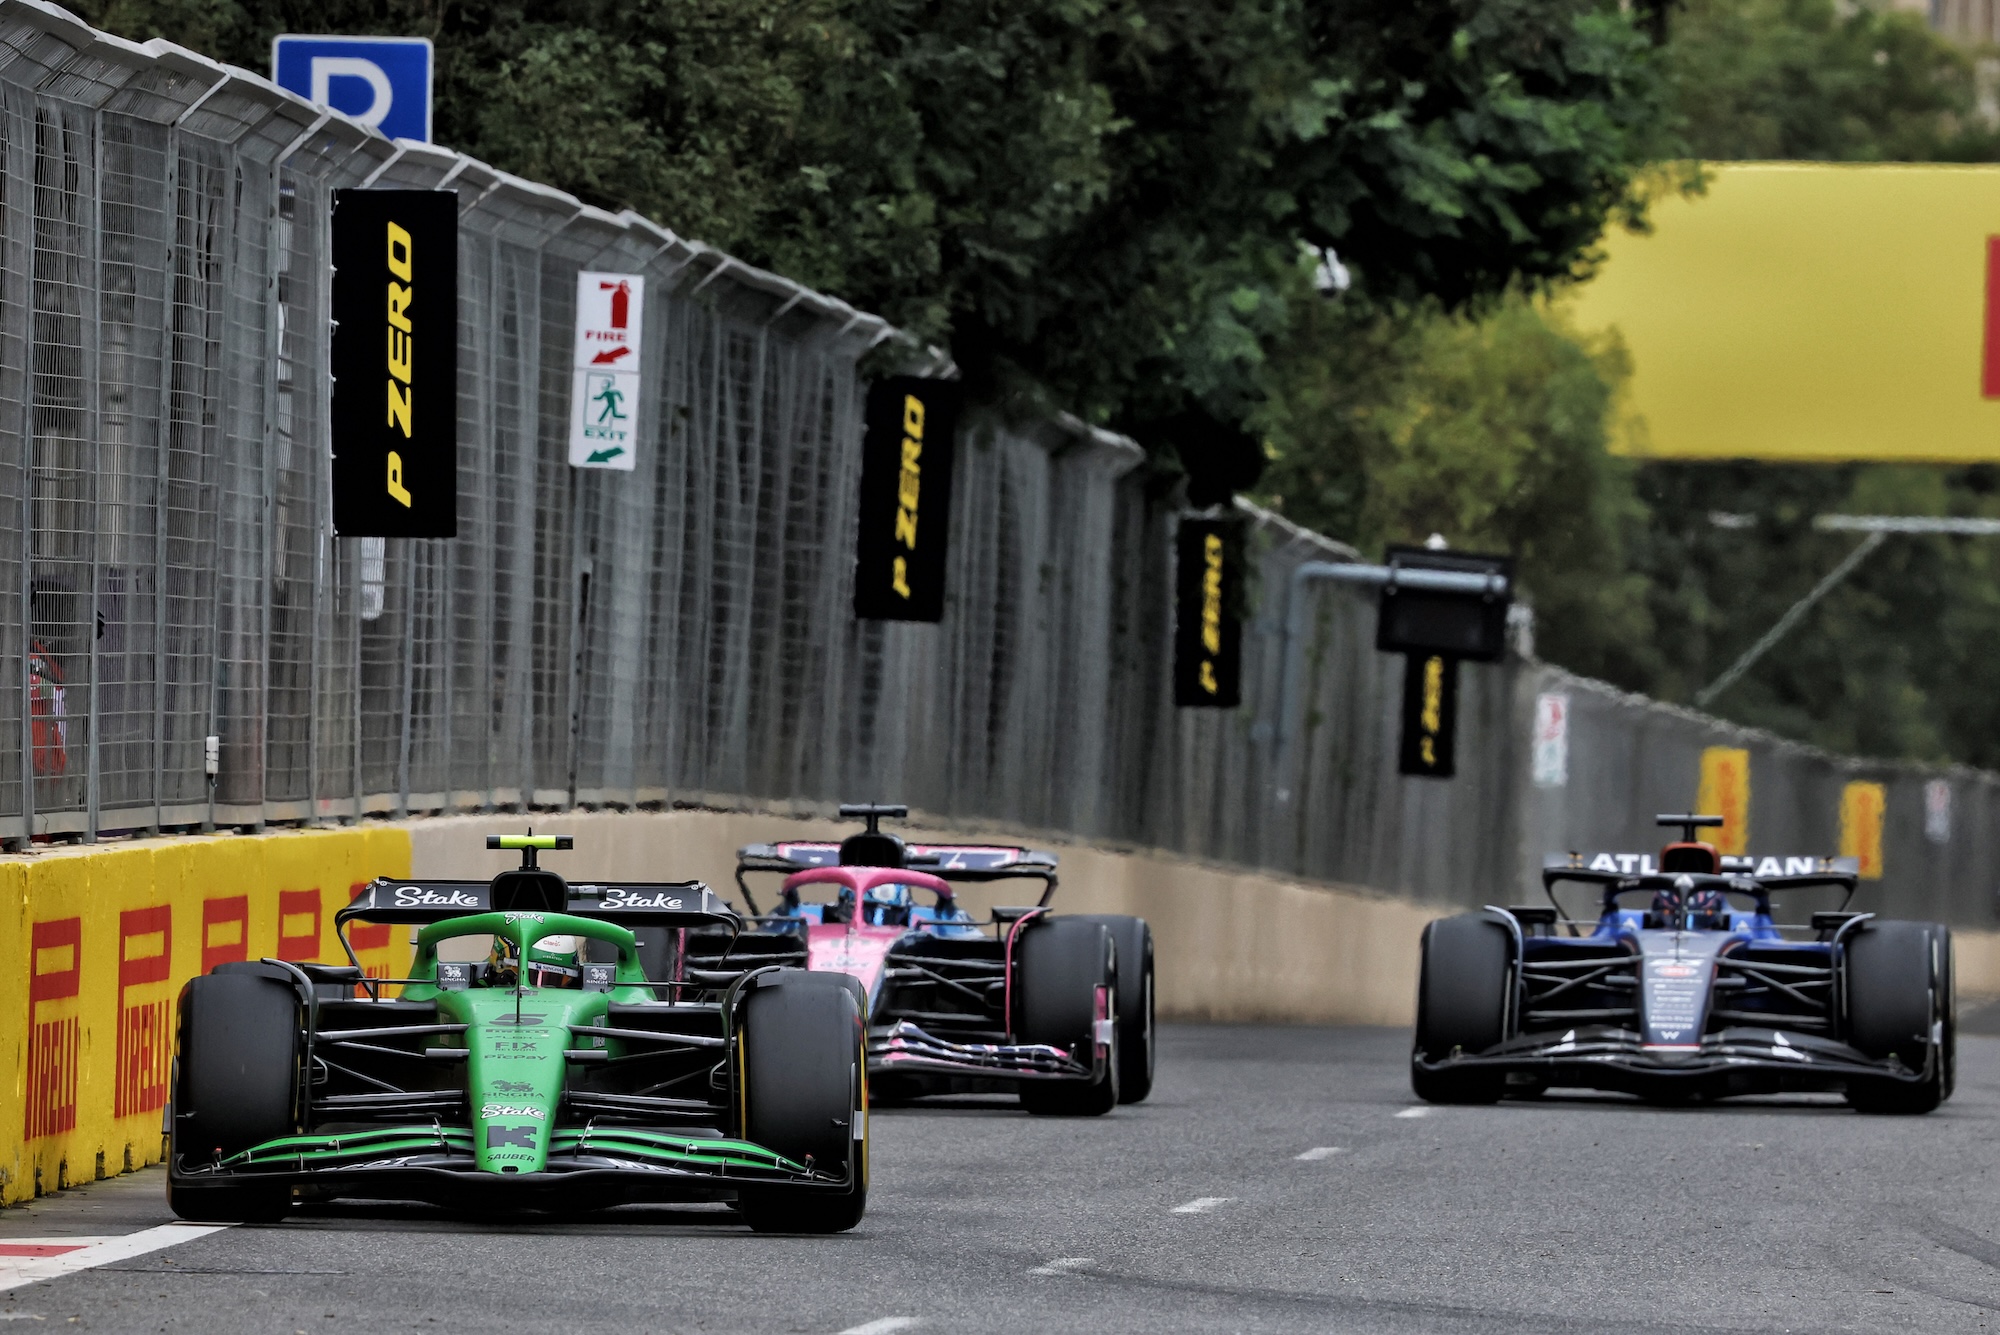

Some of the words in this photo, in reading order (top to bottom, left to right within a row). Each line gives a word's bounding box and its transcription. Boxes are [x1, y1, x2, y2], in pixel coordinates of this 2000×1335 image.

[388, 221, 412, 438] ZERO
[585, 329, 627, 342] FIRE
[583, 428, 628, 441] EXIT
[388, 451, 411, 508] P
[895, 395, 925, 550] ZERO
[893, 556, 910, 599] P
[394, 886, 479, 908] Stake
[599, 888, 683, 910] Stake
[504, 912, 545, 924] Stake
[114, 904, 171, 1119] PIRELLI
[488, 1013, 548, 1026] 5
[24, 917, 81, 1142] PIRELLI
[480, 1103, 546, 1120] Stake
[487, 1153, 535, 1162] SAUBER
